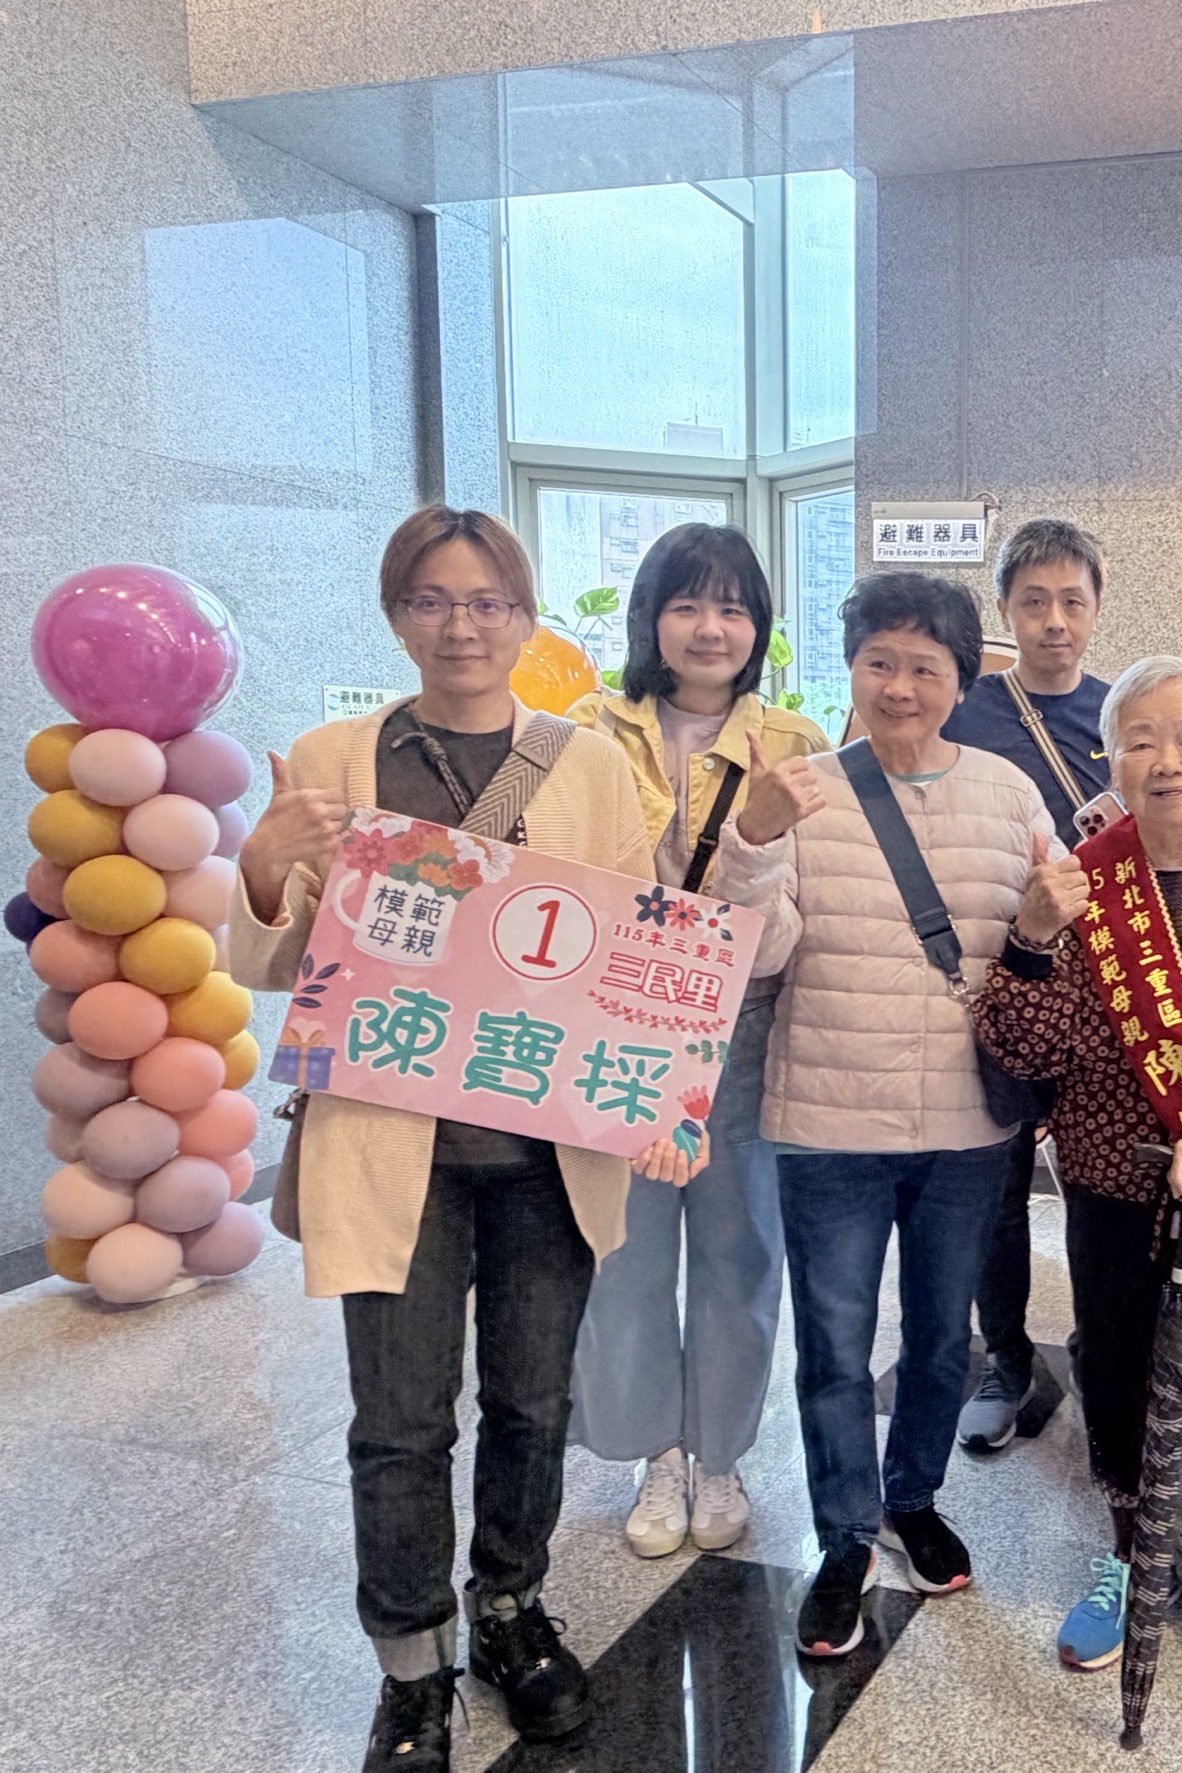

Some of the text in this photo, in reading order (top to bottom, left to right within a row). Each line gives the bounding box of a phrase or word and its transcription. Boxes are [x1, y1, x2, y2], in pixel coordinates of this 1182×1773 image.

[877, 548, 979, 558] Fire Escape Equipment
[879, 523, 979, 543] 避難器具
[374, 885, 446, 926] 模範
[367, 925, 436, 957] 母親
[520, 899, 562, 970] 1
[600, 952, 723, 1013] 三民里
[348, 987, 673, 1125] 陳寶採
